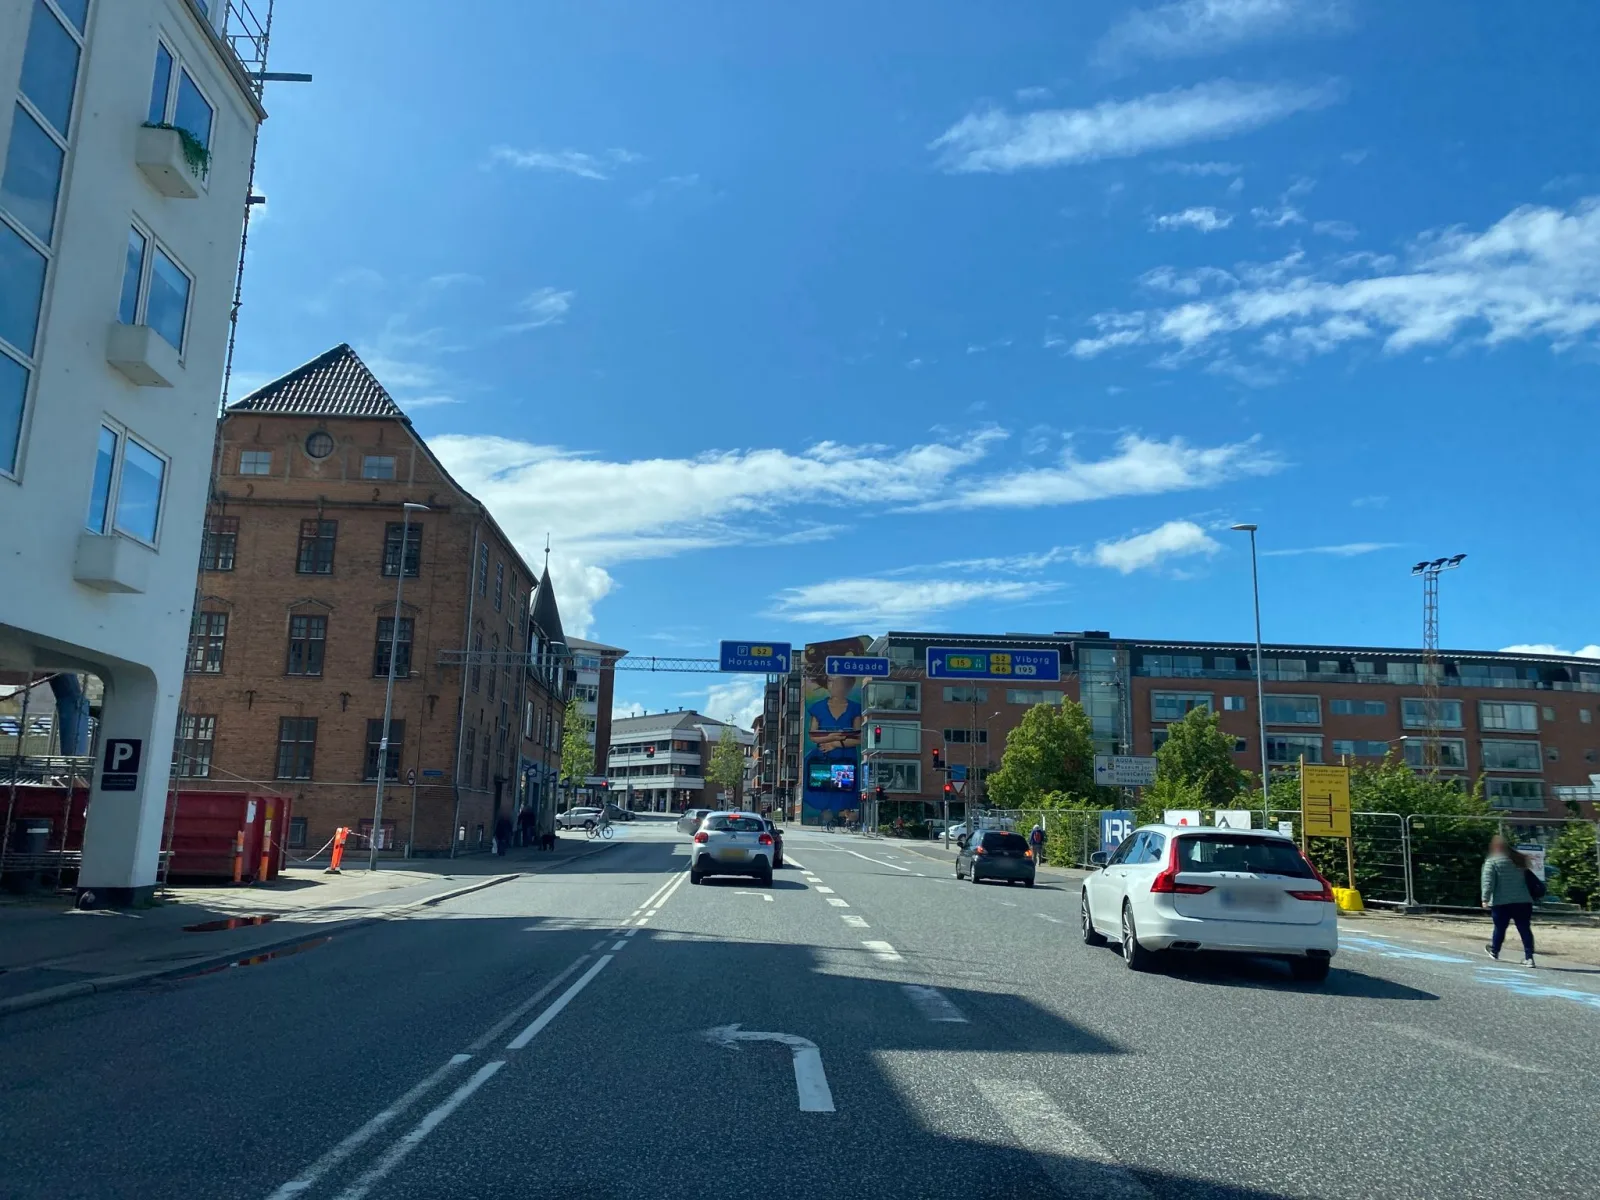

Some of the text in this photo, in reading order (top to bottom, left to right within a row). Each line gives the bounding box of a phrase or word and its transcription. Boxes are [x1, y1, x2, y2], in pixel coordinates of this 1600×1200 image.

[757, 648, 767, 656] 52
[728, 657, 772, 667] Horsens
[1015, 655, 1050, 665] Viborg
[844, 661, 884, 672] Gågade
[1018, 666, 1033, 674] 195
[112, 742, 133, 770] P
